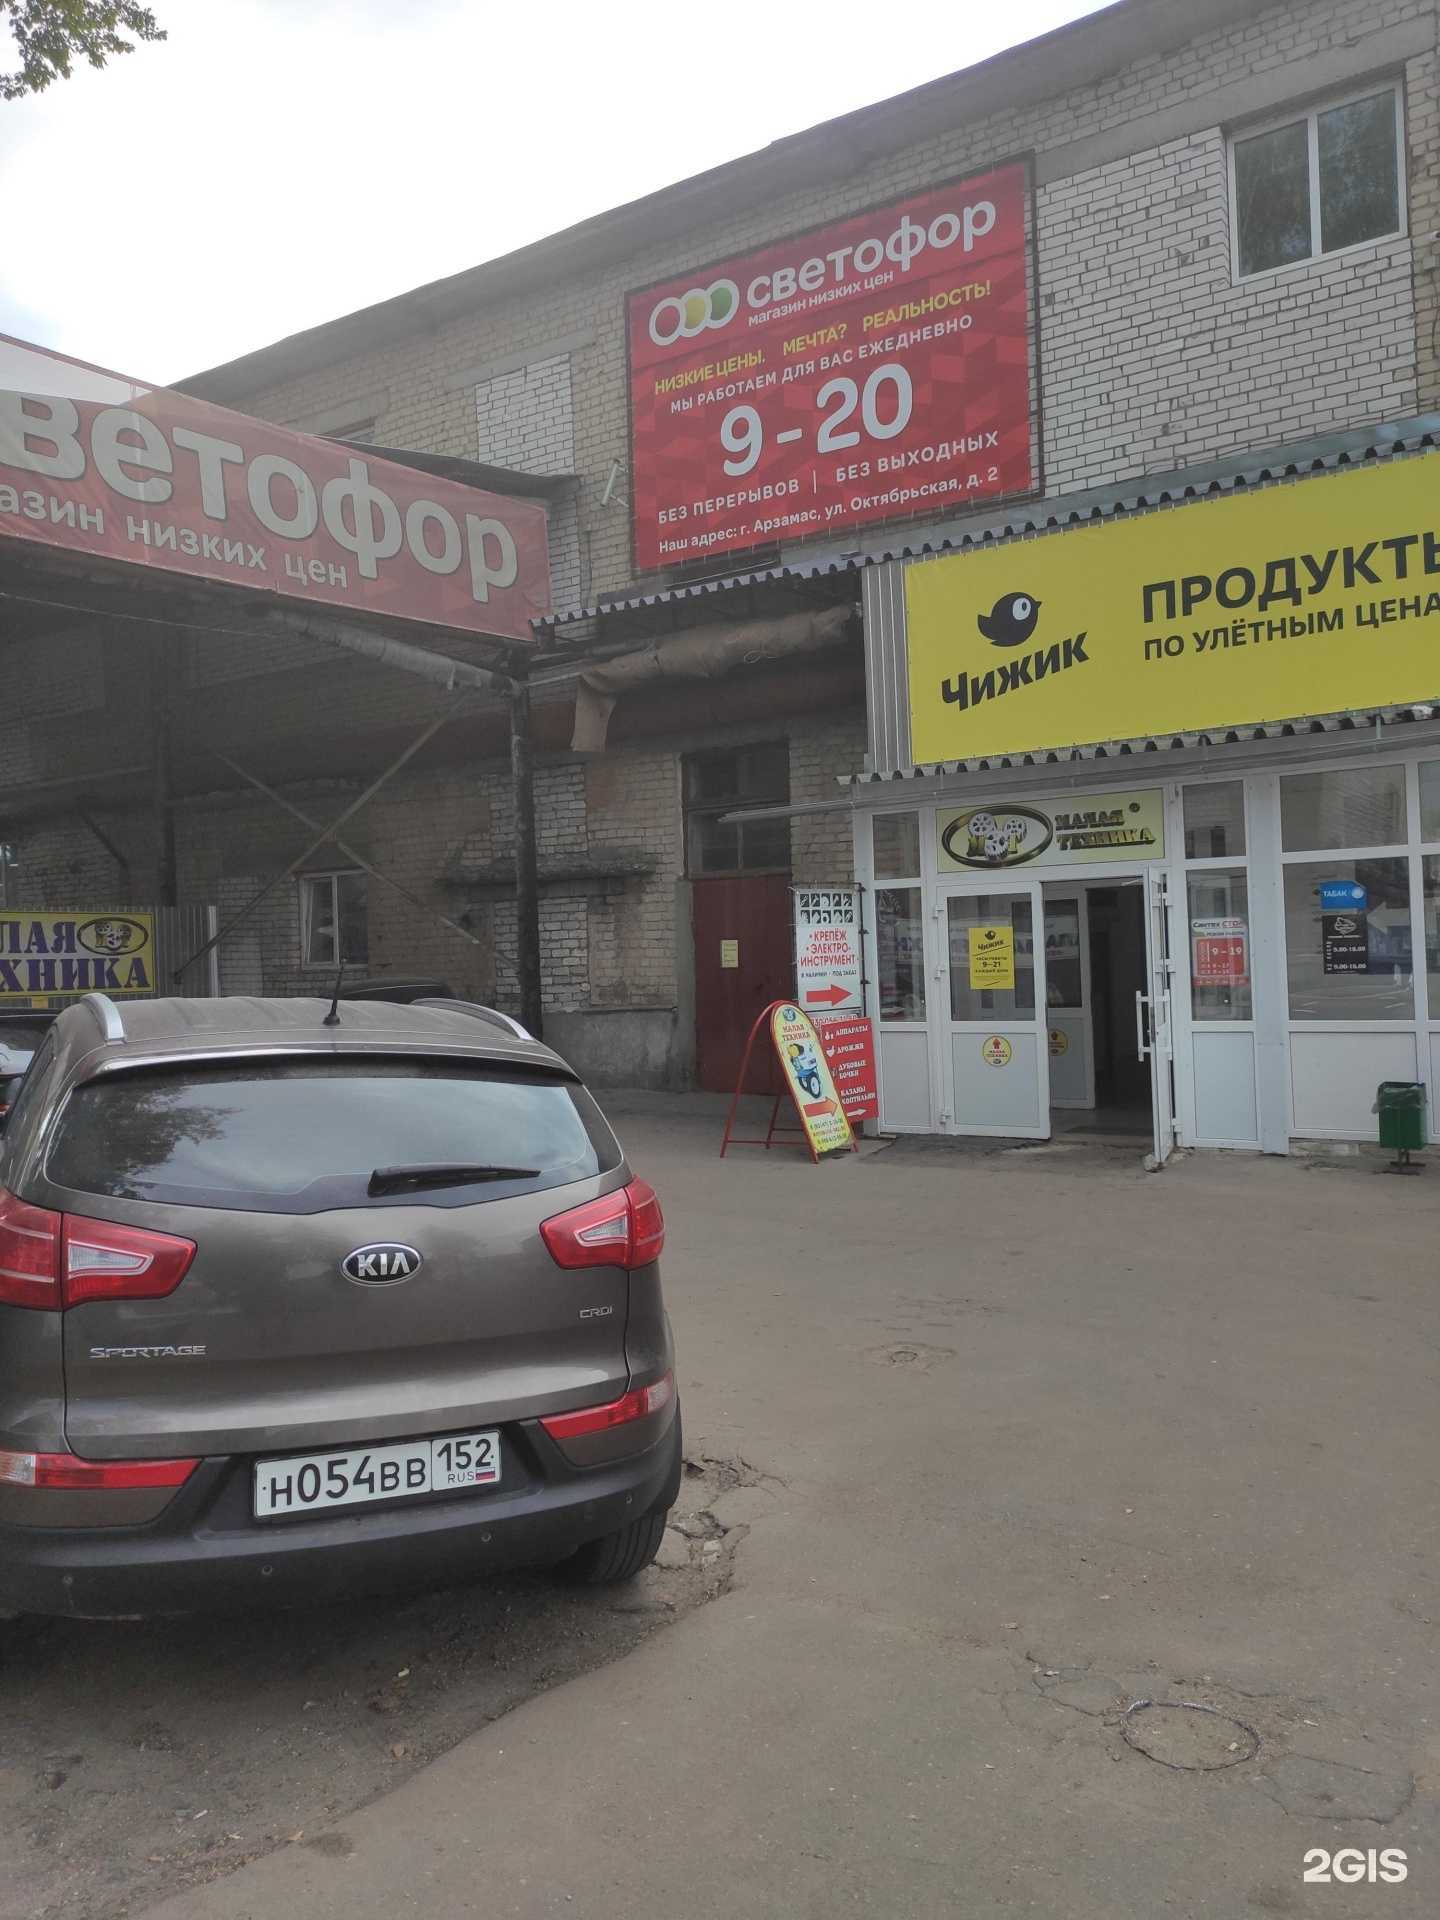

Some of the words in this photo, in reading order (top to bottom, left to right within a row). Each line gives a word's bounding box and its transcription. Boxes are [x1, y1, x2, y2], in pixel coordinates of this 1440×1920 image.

[747, 200, 997, 309] светофор
[748, 299, 807, 328] магазин
[808, 281, 862, 308] низких
[864, 270, 894, 291] цен
[655, 364, 713, 395] НИЗКИЕ
[716, 349, 766, 377] ЦЕНЫ.
[783, 323, 848, 356] МЕЧТА?
[863, 280, 992, 332] РЕАЛЬНОСТЬ!
[671, 399, 693, 414] МЫ
[698, 371, 777, 406] РАБОТАЕМ
[781, 361, 816, 384] ДЛЯ
[820, 350, 854, 371] ВАС
[858, 314, 973, 359] ЕЖЕДНЕВНО
[658, 505, 688, 524] БЕЗ
[693, 479, 800, 516] ПЕРЕРЫВОВ
[836, 462, 871, 482] БЕЗ
[877, 430, 999, 473] ВЫХОДНЫХ
[659, 539, 688, 554] Наш
[691, 527, 738, 548] адрес:
[740, 522, 751, 535] г.
[754, 508, 821, 534] Арзамас,
[825, 503, 847, 519] ул.
[850, 478, 962, 511] Октябрьская,
[966, 473, 984, 489] д.
[987, 466, 998, 482] 2
[127, 514, 268, 571] низких
[284, 552, 348, 588] цен
[1144, 635, 1185, 661] ПО
[1193, 607, 1344, 653] УЛЁТНЫМ
[800, 954, 856, 967] ИНСТРУМЕНТ
[814, 929, 847, 941] КРЕПЁЖ
[835, 1024, 868, 1037] АППАРАТЫ
[357, 1252, 411, 1277] KIA
[89, 1345, 207, 1359] SPORTAGE
[436, 1438, 492, 1472] 152
[447, 1471, 475, 1484] RUS
